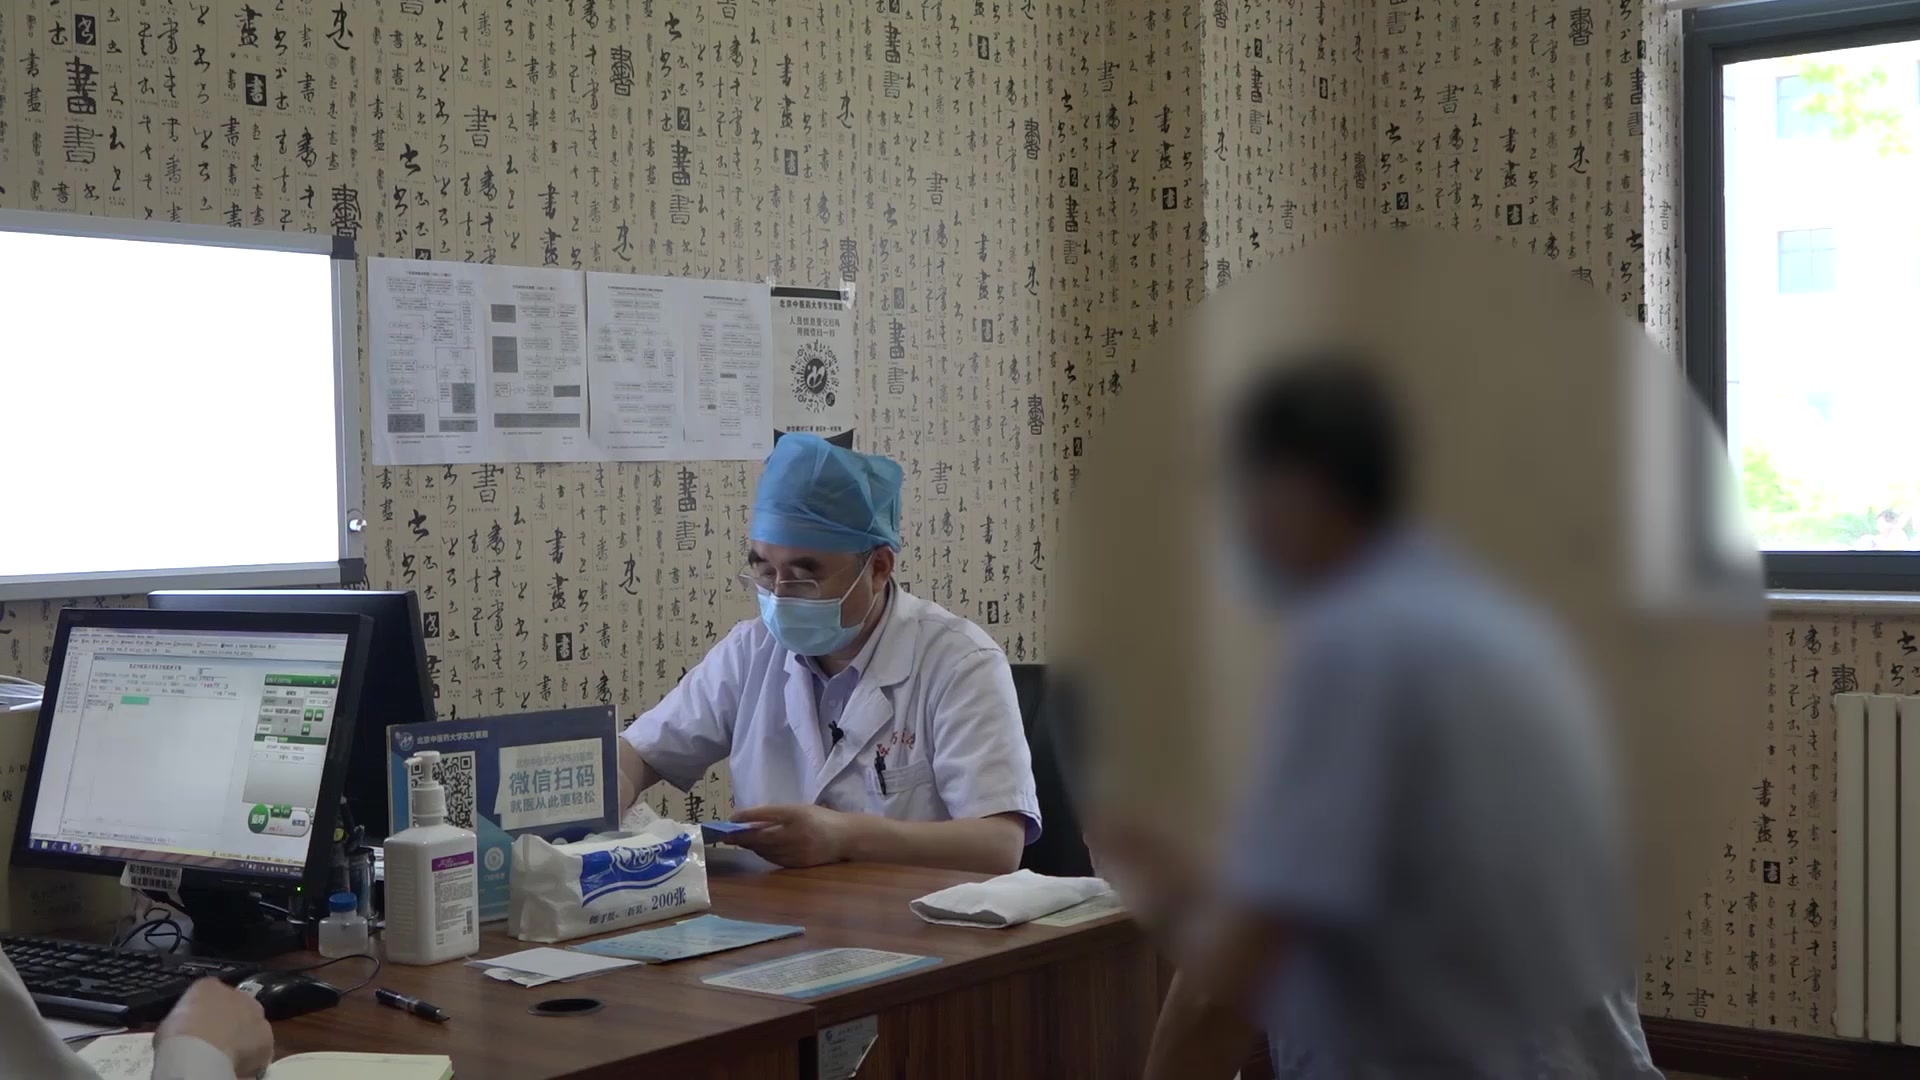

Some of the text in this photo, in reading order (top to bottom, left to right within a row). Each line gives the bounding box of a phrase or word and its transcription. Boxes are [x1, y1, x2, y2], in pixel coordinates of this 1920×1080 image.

[417, 730, 488, 745] 北京中医药大学东方医院
[509, 764, 595, 796] 微信扫码
[510, 791, 595, 813] 就医从此更轻松
[652, 886, 686, 911] 200张
